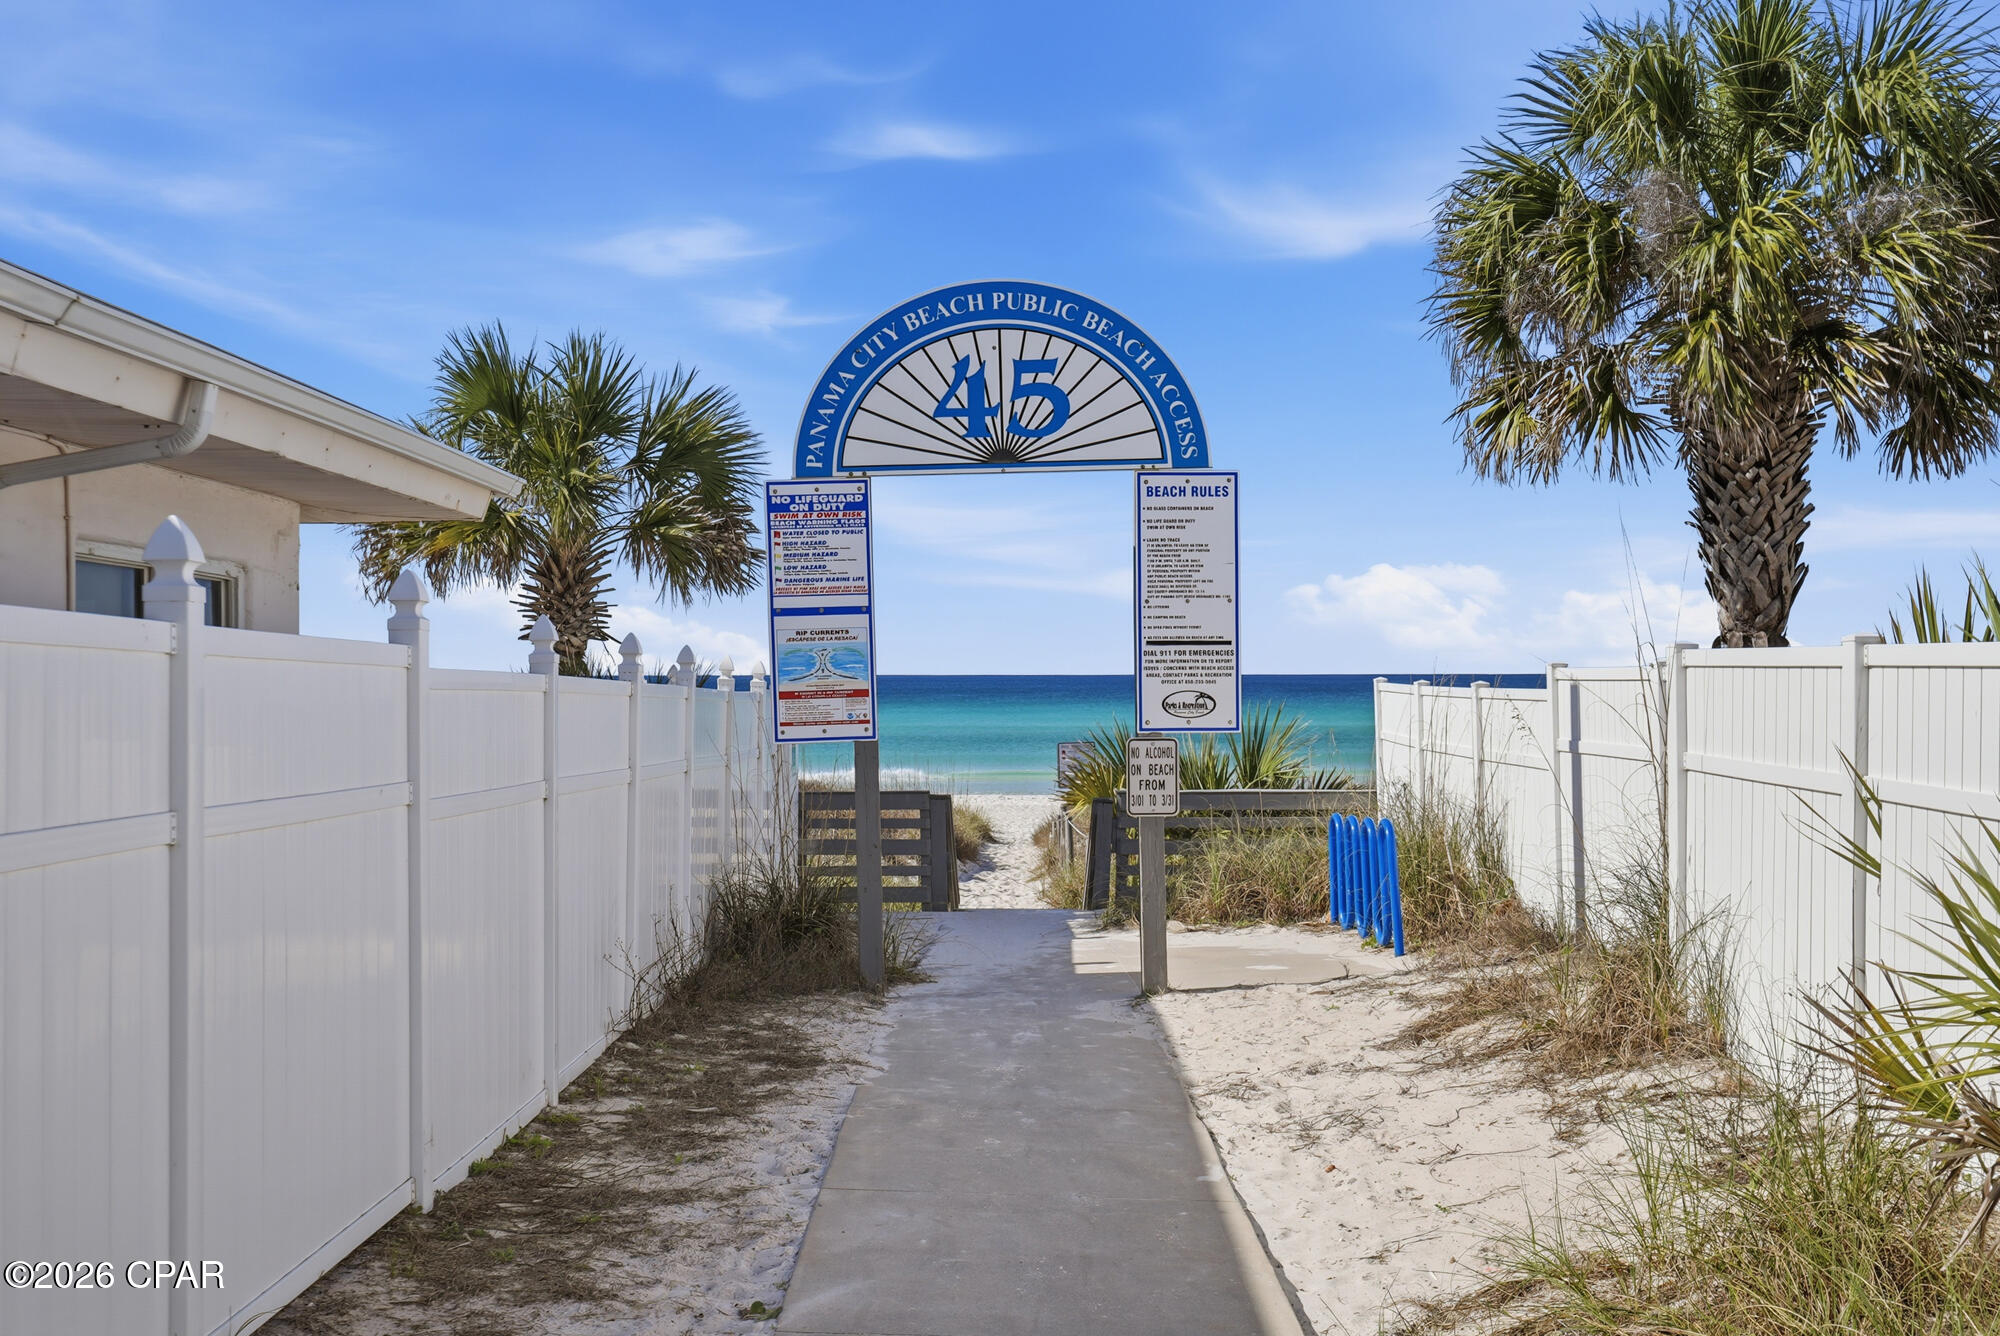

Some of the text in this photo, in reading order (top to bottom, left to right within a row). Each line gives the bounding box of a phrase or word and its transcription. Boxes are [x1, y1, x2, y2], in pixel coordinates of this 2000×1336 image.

[806, 292, 1198, 469] PANAMA CITY BEACH PUBLIC BEACH ACCESS
[933, 354, 1071, 438] 45
[1147, 486, 1229, 497] BEACH RULES
[795, 495, 863, 503] LIFEGUARD
[1131, 747, 1174, 758] NO ALCOHOL
[1131, 764, 1174, 775] ON BEACH
[1139, 780, 1165, 790] FROM
[1131, 795, 1174, 806] 3/01 TO 3/31
